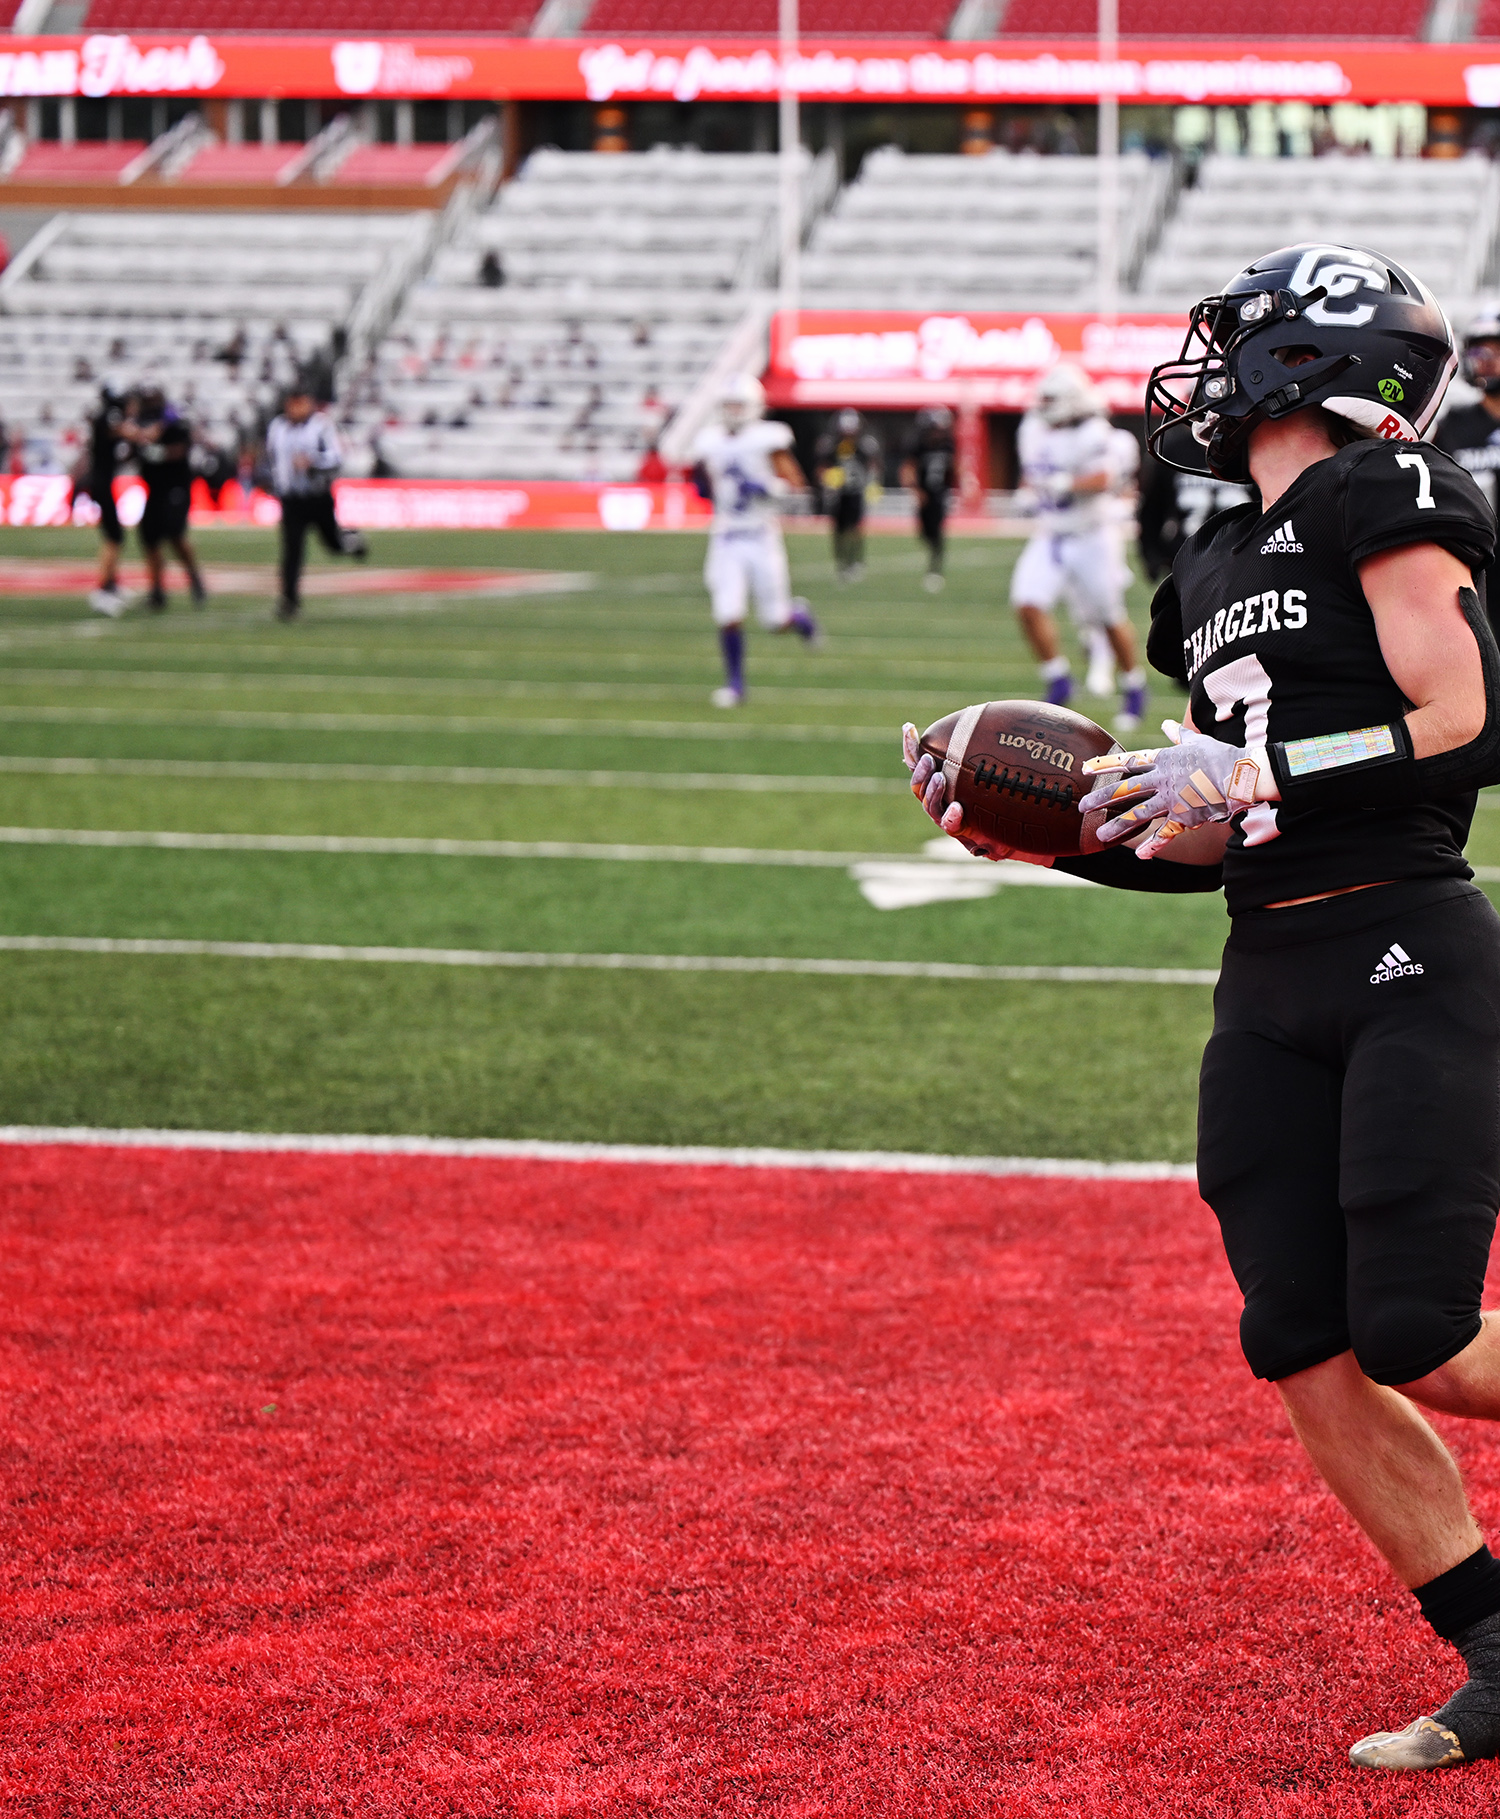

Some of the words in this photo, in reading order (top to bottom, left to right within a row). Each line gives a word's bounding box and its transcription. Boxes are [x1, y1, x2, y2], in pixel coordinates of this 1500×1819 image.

[1381, 380, 1401, 400] PN
[1394, 453, 1436, 509] 7
[1260, 540, 1304, 555] adidas
[1183, 589, 1308, 681] CHARGERS
[999, 732, 1075, 773] Wilson
[1203, 653, 1282, 847] 7
[1370, 963, 1424, 984] adidas
